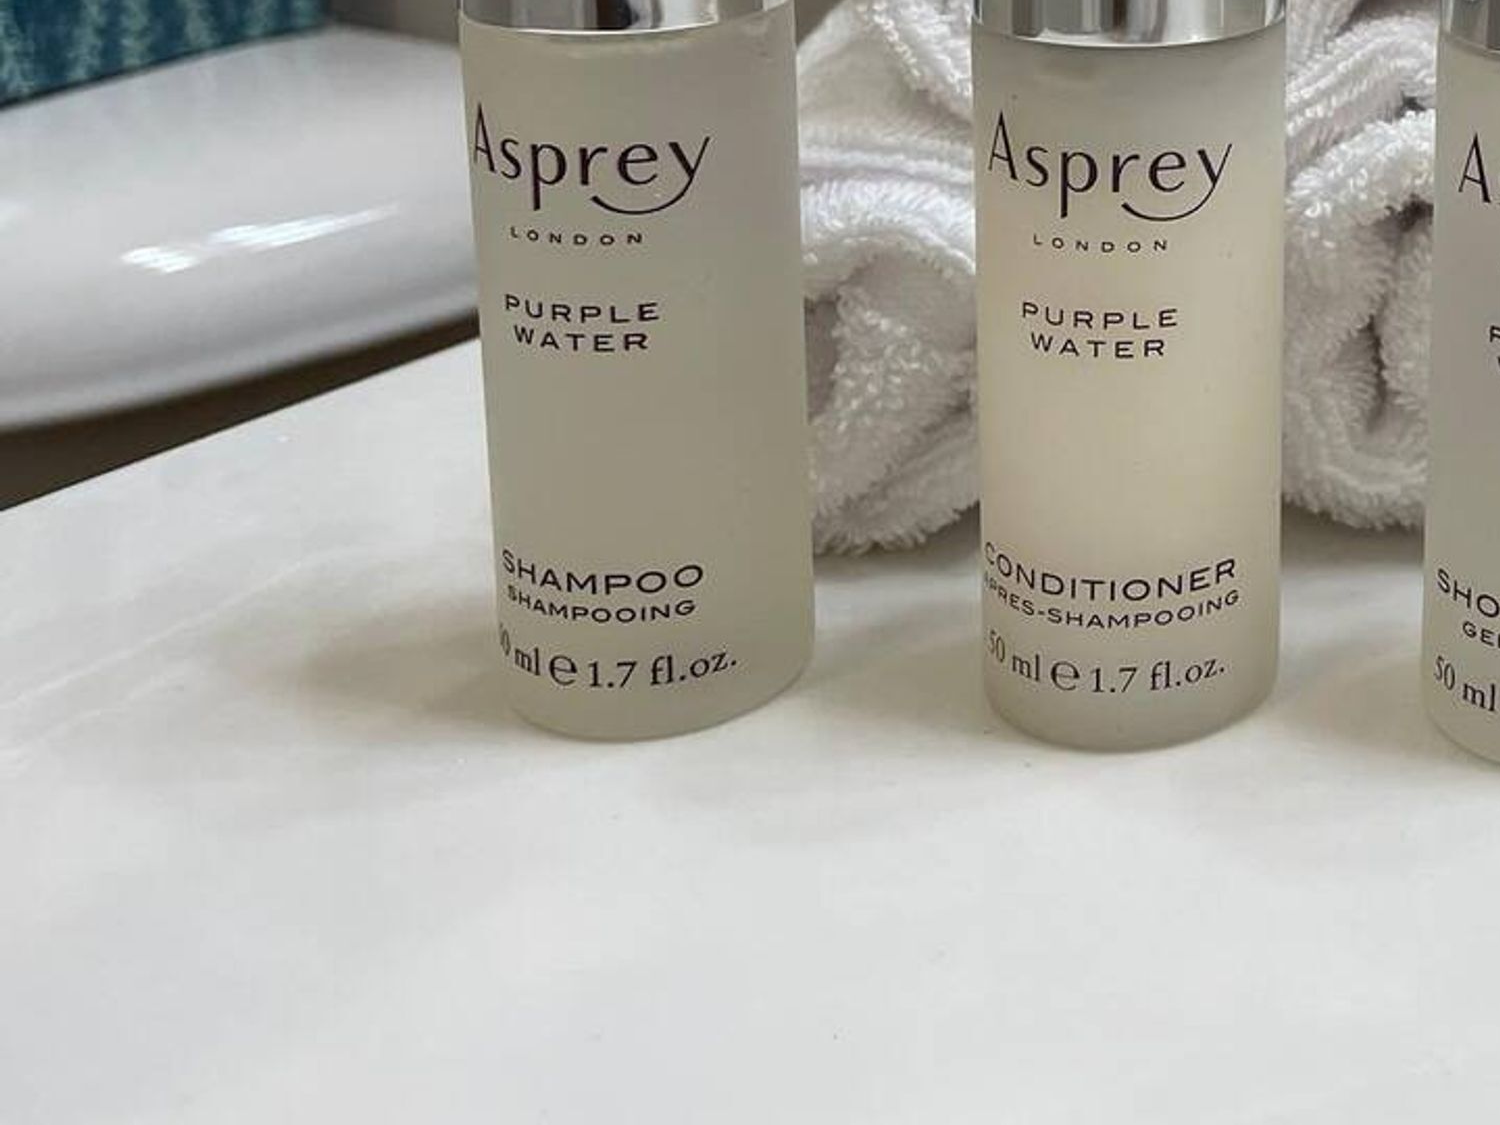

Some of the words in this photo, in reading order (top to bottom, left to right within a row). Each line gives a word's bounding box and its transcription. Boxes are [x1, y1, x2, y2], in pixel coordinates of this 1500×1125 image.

[473, 102, 711, 215] Asprey
[988, 110, 1233, 222] Asprey
[510, 226, 644, 246] LONDON
[1033, 234, 1168, 253] LONDON
[504, 294, 660, 324] PURPLE
[1021, 301, 1179, 330] PURPLE
[513, 324, 649, 352] WATER
[1030, 332, 1165, 359] WATER
[502, 549, 704, 595] SHAMPOO
[984, 541, 1236, 602] CONDITIONER
[507, 584, 697, 624] SHAMPOOING
[500, 622, 512, 656] 0
[514, 646, 541, 676] ml
[588, 661, 638, 688] 1.7
[649, 648, 737, 686] fl.oz.
[1011, 654, 1041, 682] ml
[1091, 667, 1138, 694] 1.7
[1149, 658, 1226, 692] fl.oz.
[1433, 655, 1456, 691] 50
[1462, 683, 1497, 712] ml
